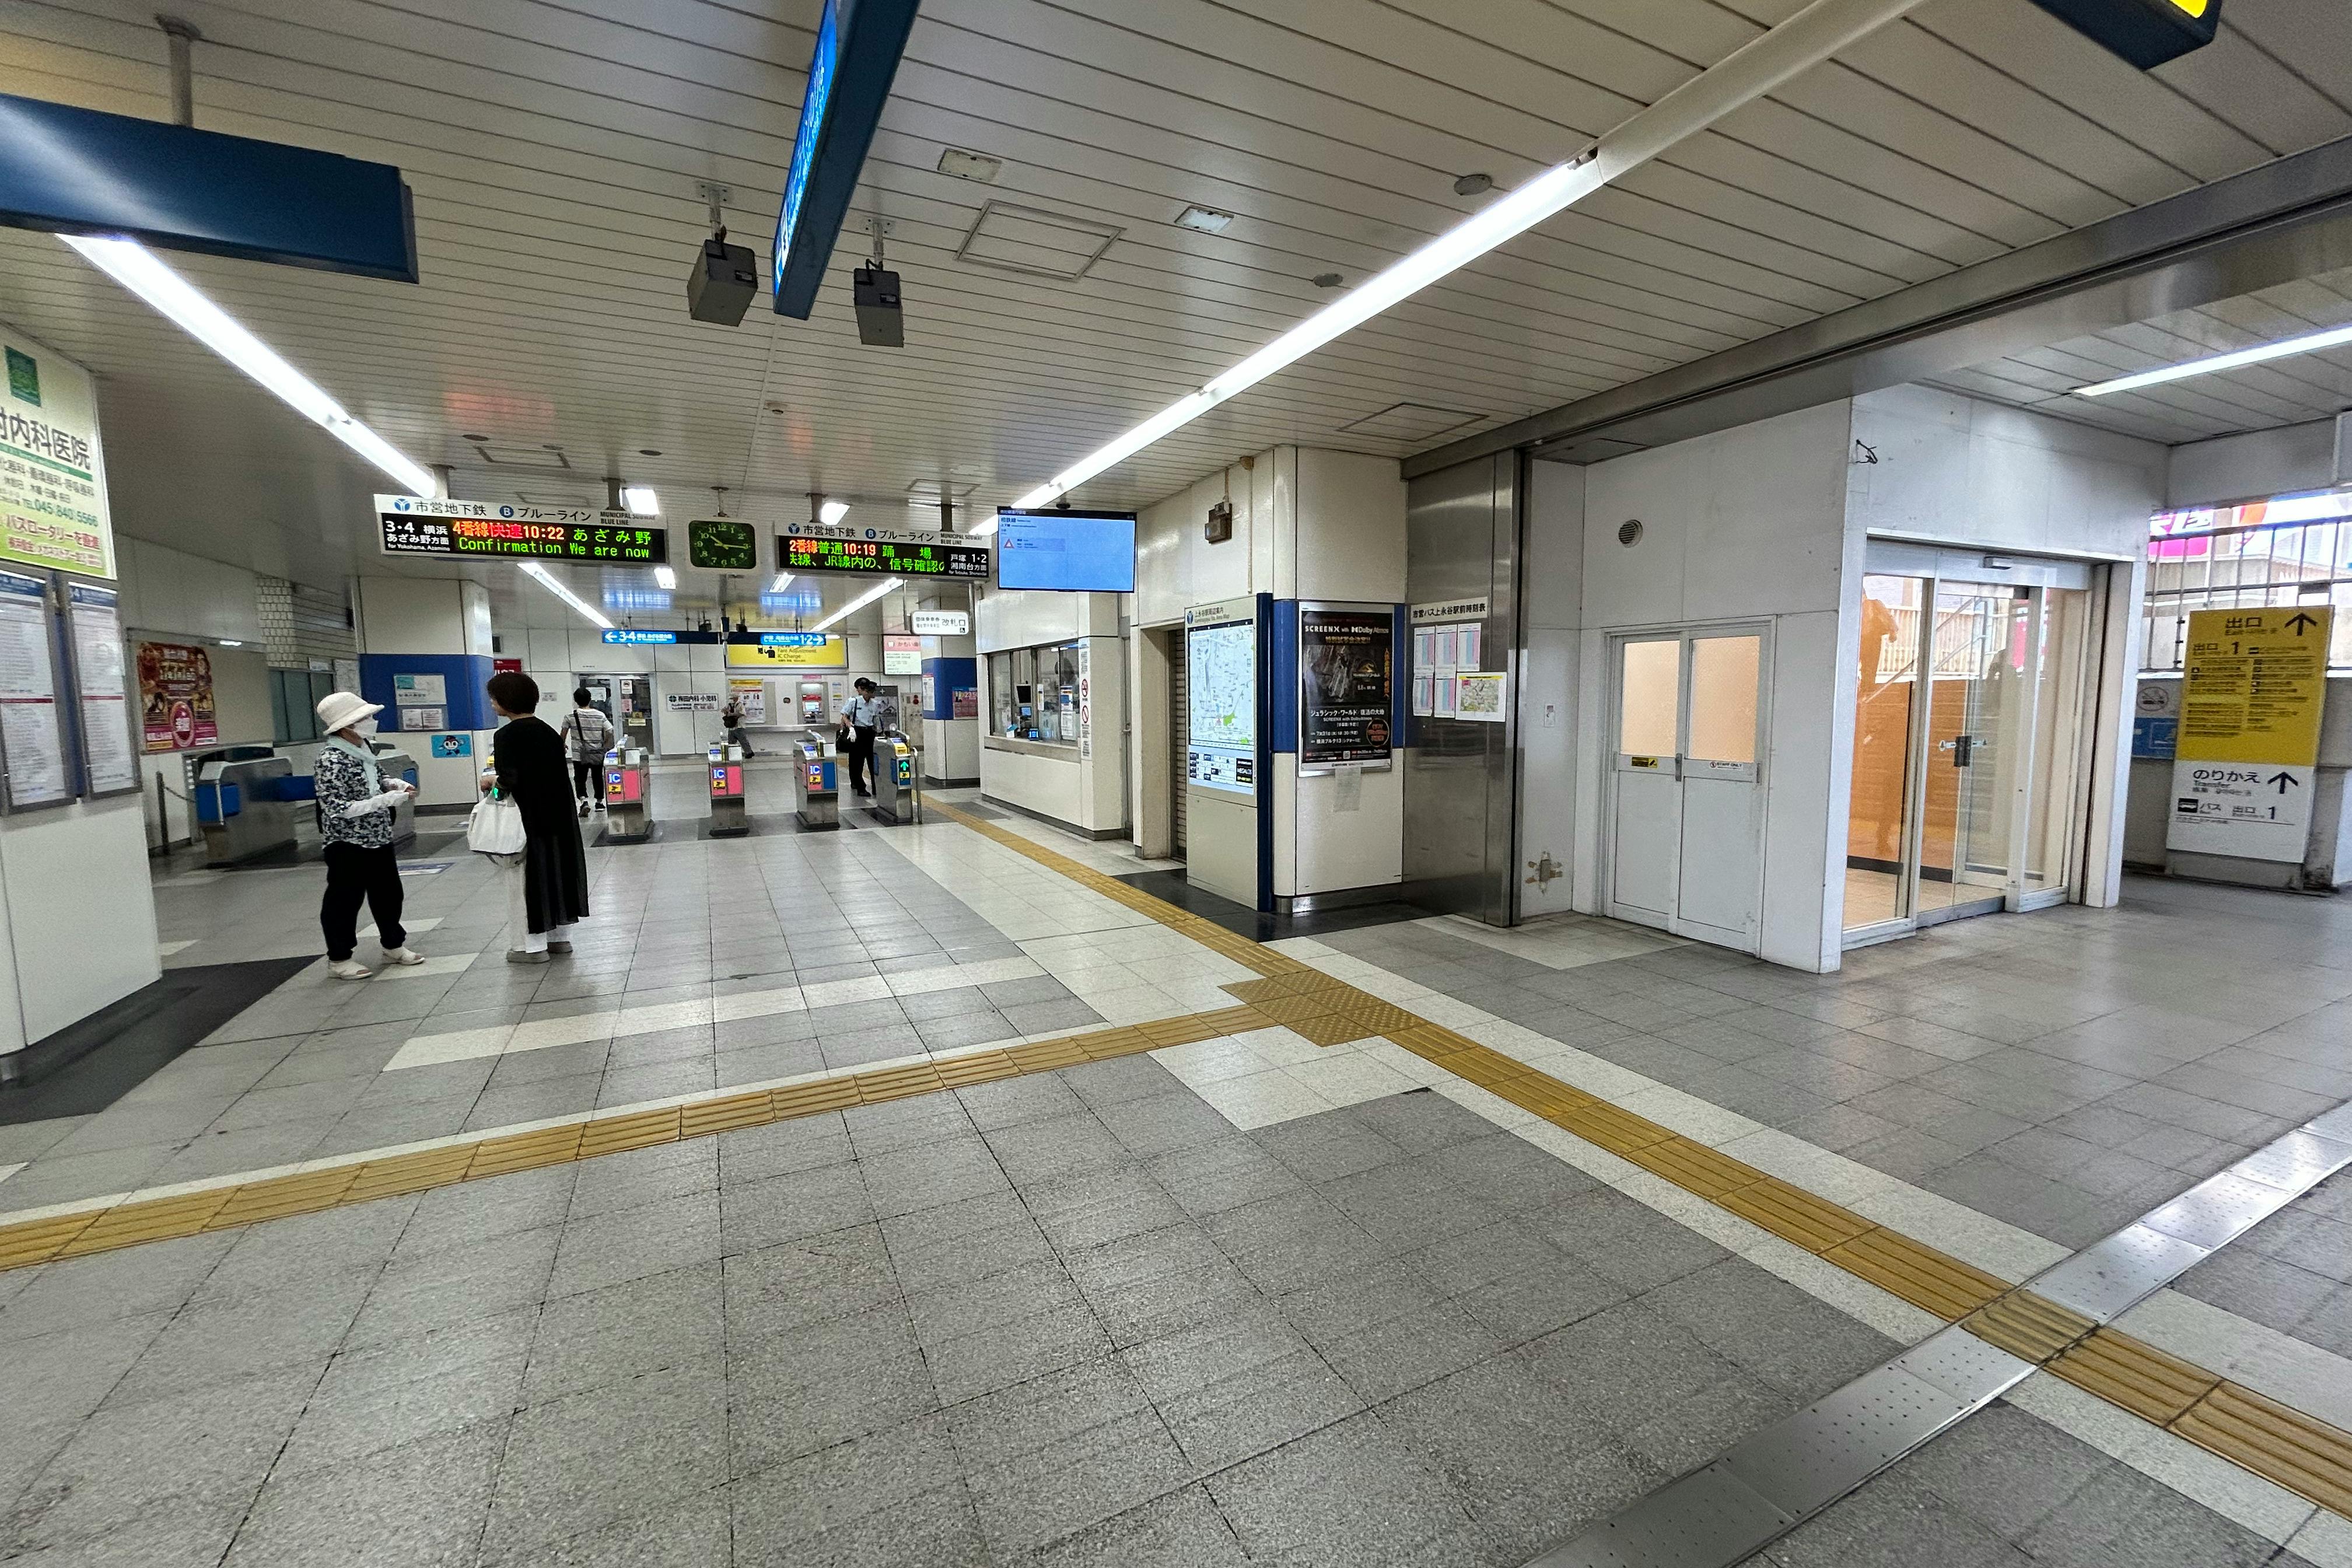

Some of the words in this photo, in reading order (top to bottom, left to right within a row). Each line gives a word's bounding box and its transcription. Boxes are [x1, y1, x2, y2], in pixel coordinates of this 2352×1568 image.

[415, 501, 487, 516] 市営地下鉄
[518, 508, 591, 521] ブルーライン
[803, 525, 856, 538] 市営地下鉄
[880, 530, 934, 541] ブルーライン
[459, 537, 562, 554] Confirmation
[569, 542, 586, 555] We
[594, 547, 618, 556] are
[625, 548, 649, 558] now
[2225, 617, 2262, 629] 出口
[2231, 642, 2239, 654] 1
[713, 769, 725, 779] IC
[810, 765, 820, 775] IC
[2192, 769, 2260, 784] のりかえ
[608, 773, 621, 783] IC
[2199, 802, 2221, 811] バス
[2232, 806, 2256, 814] 出口
[2267, 807, 2276, 820] 1
